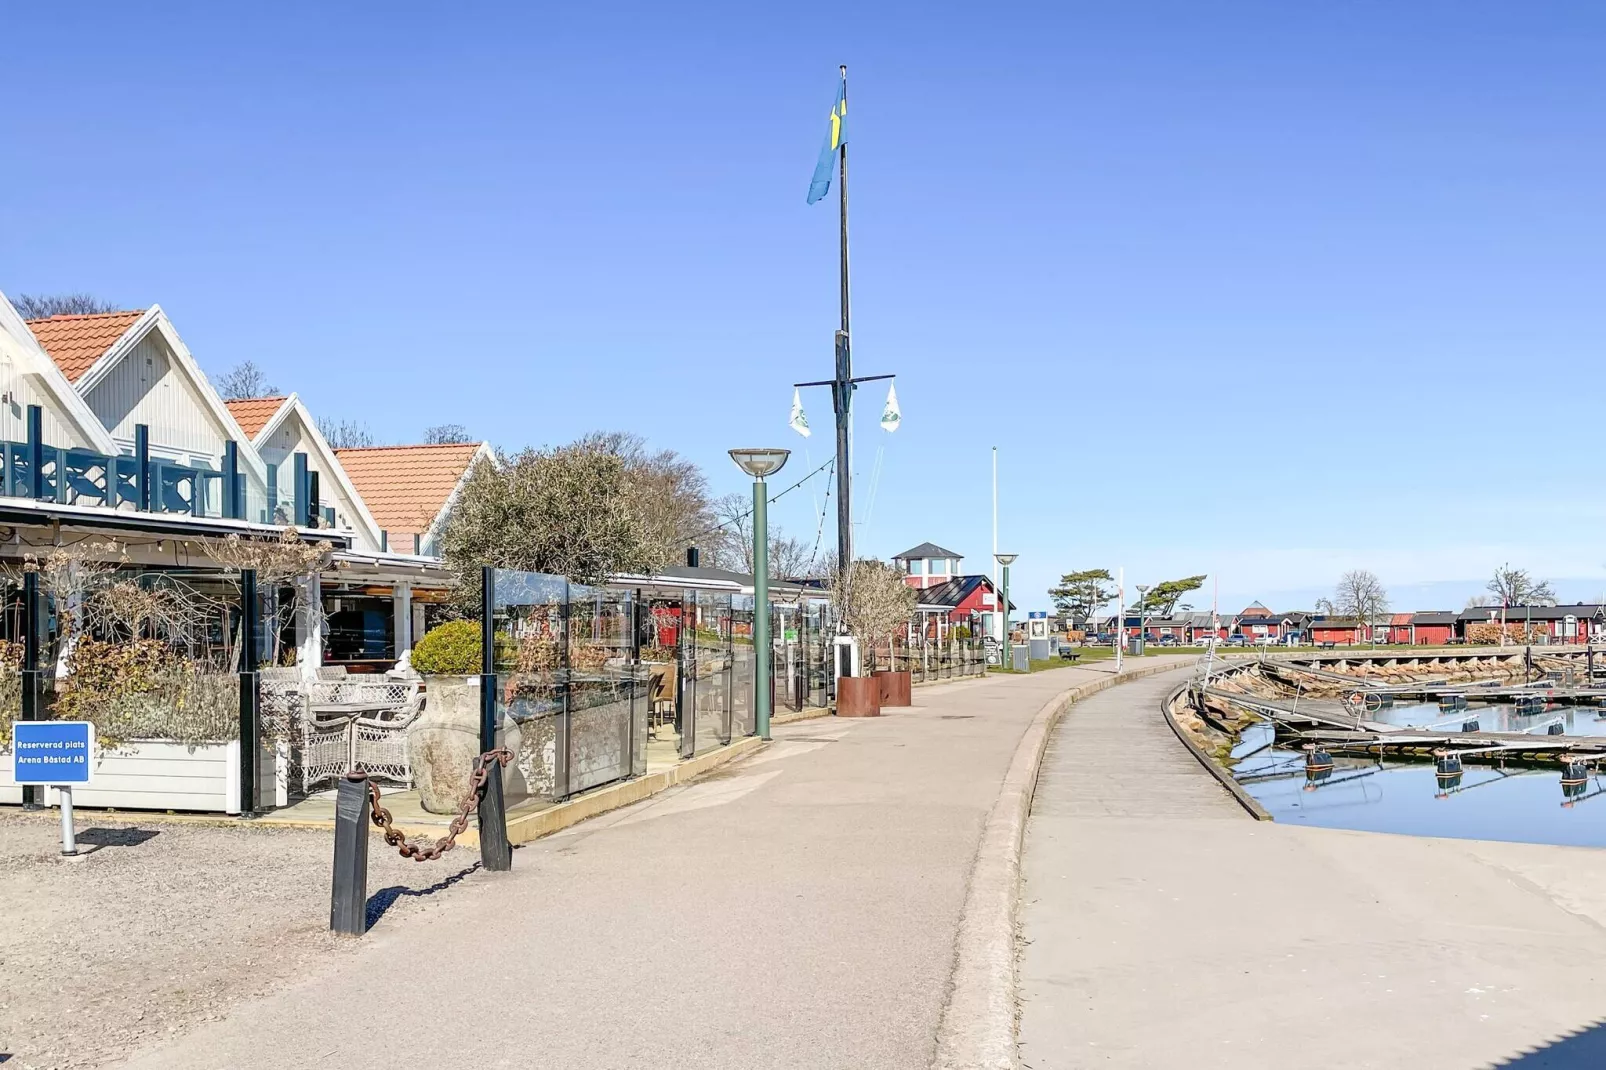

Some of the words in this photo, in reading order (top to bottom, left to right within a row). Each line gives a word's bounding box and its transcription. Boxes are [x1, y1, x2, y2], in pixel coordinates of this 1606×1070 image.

[17, 741, 63, 749] Reserverad
[65, 741, 85, 750] plats
[43, 755, 71, 763] Båstad
[74, 755, 85, 763] AB
